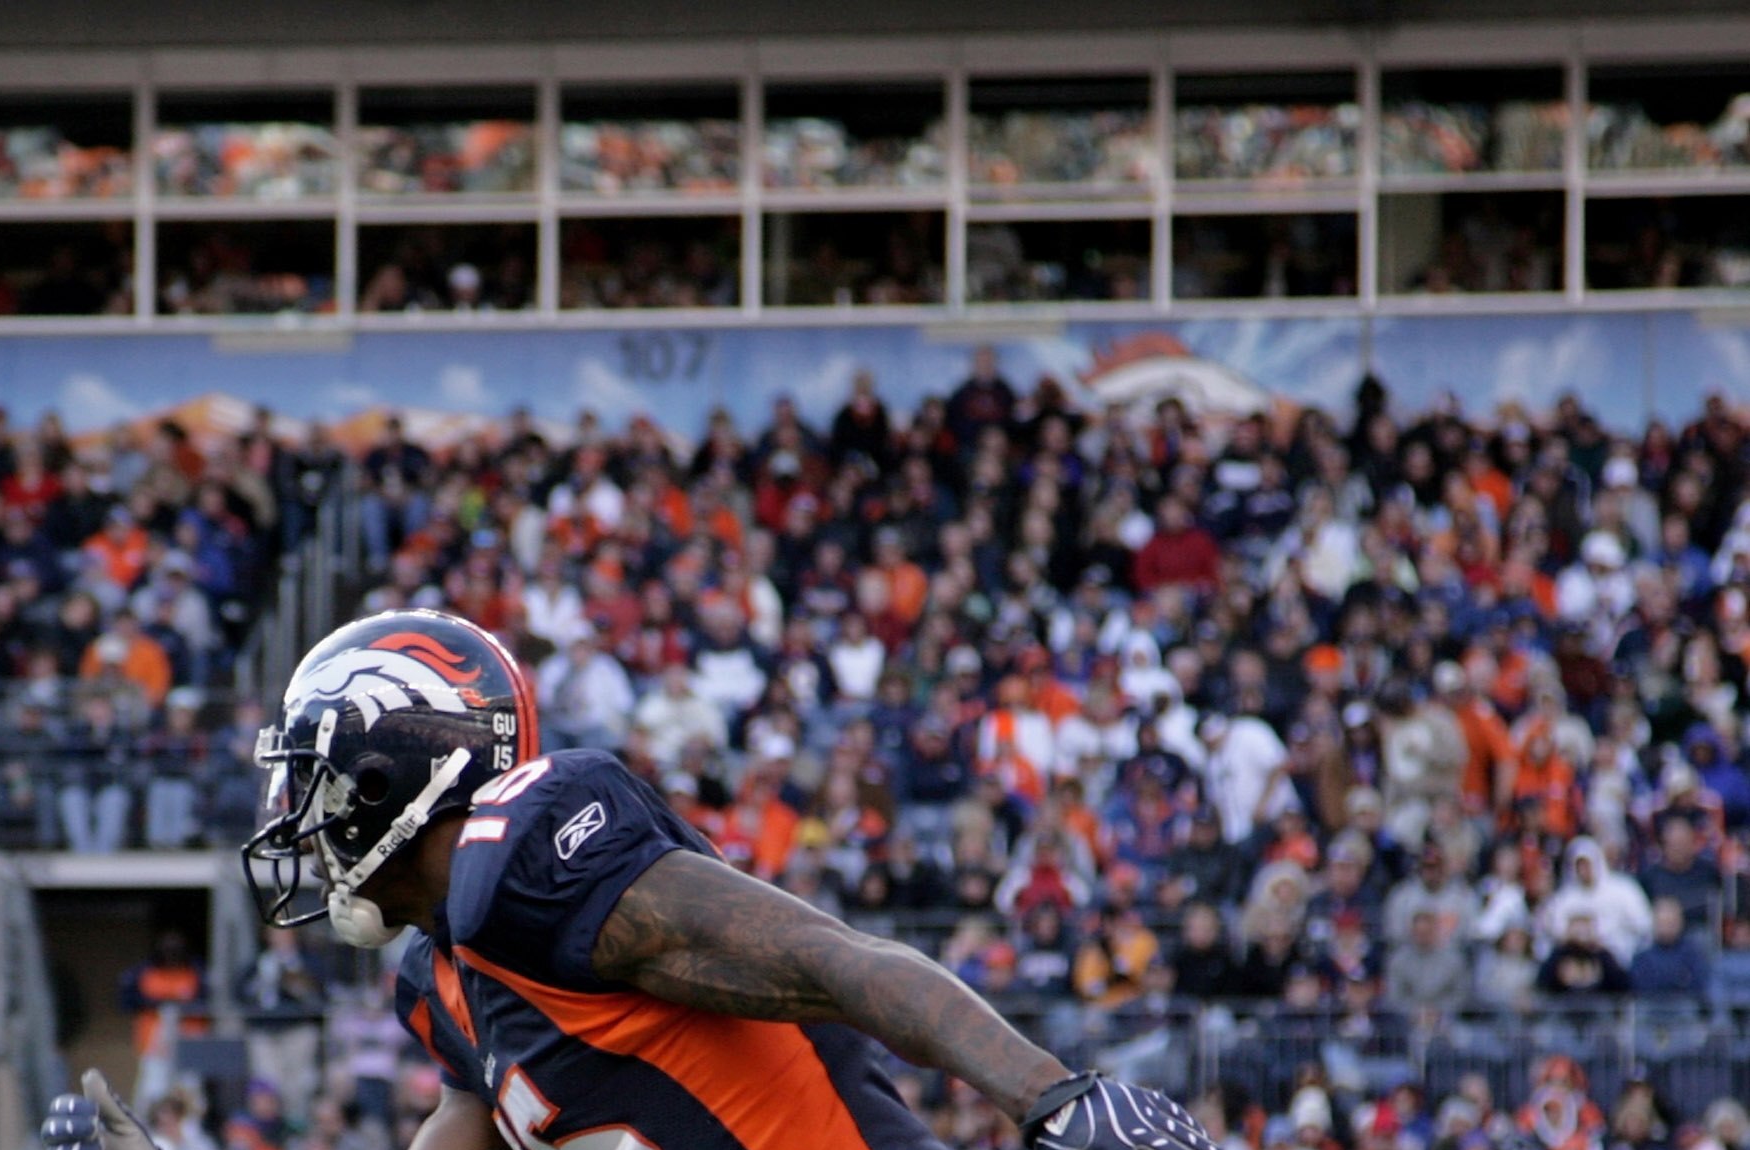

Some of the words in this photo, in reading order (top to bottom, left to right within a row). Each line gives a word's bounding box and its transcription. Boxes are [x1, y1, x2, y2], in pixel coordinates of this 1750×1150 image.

[618, 329, 711, 384] 107
[492, 713, 516, 736] GU
[492, 744, 513, 771] 15
